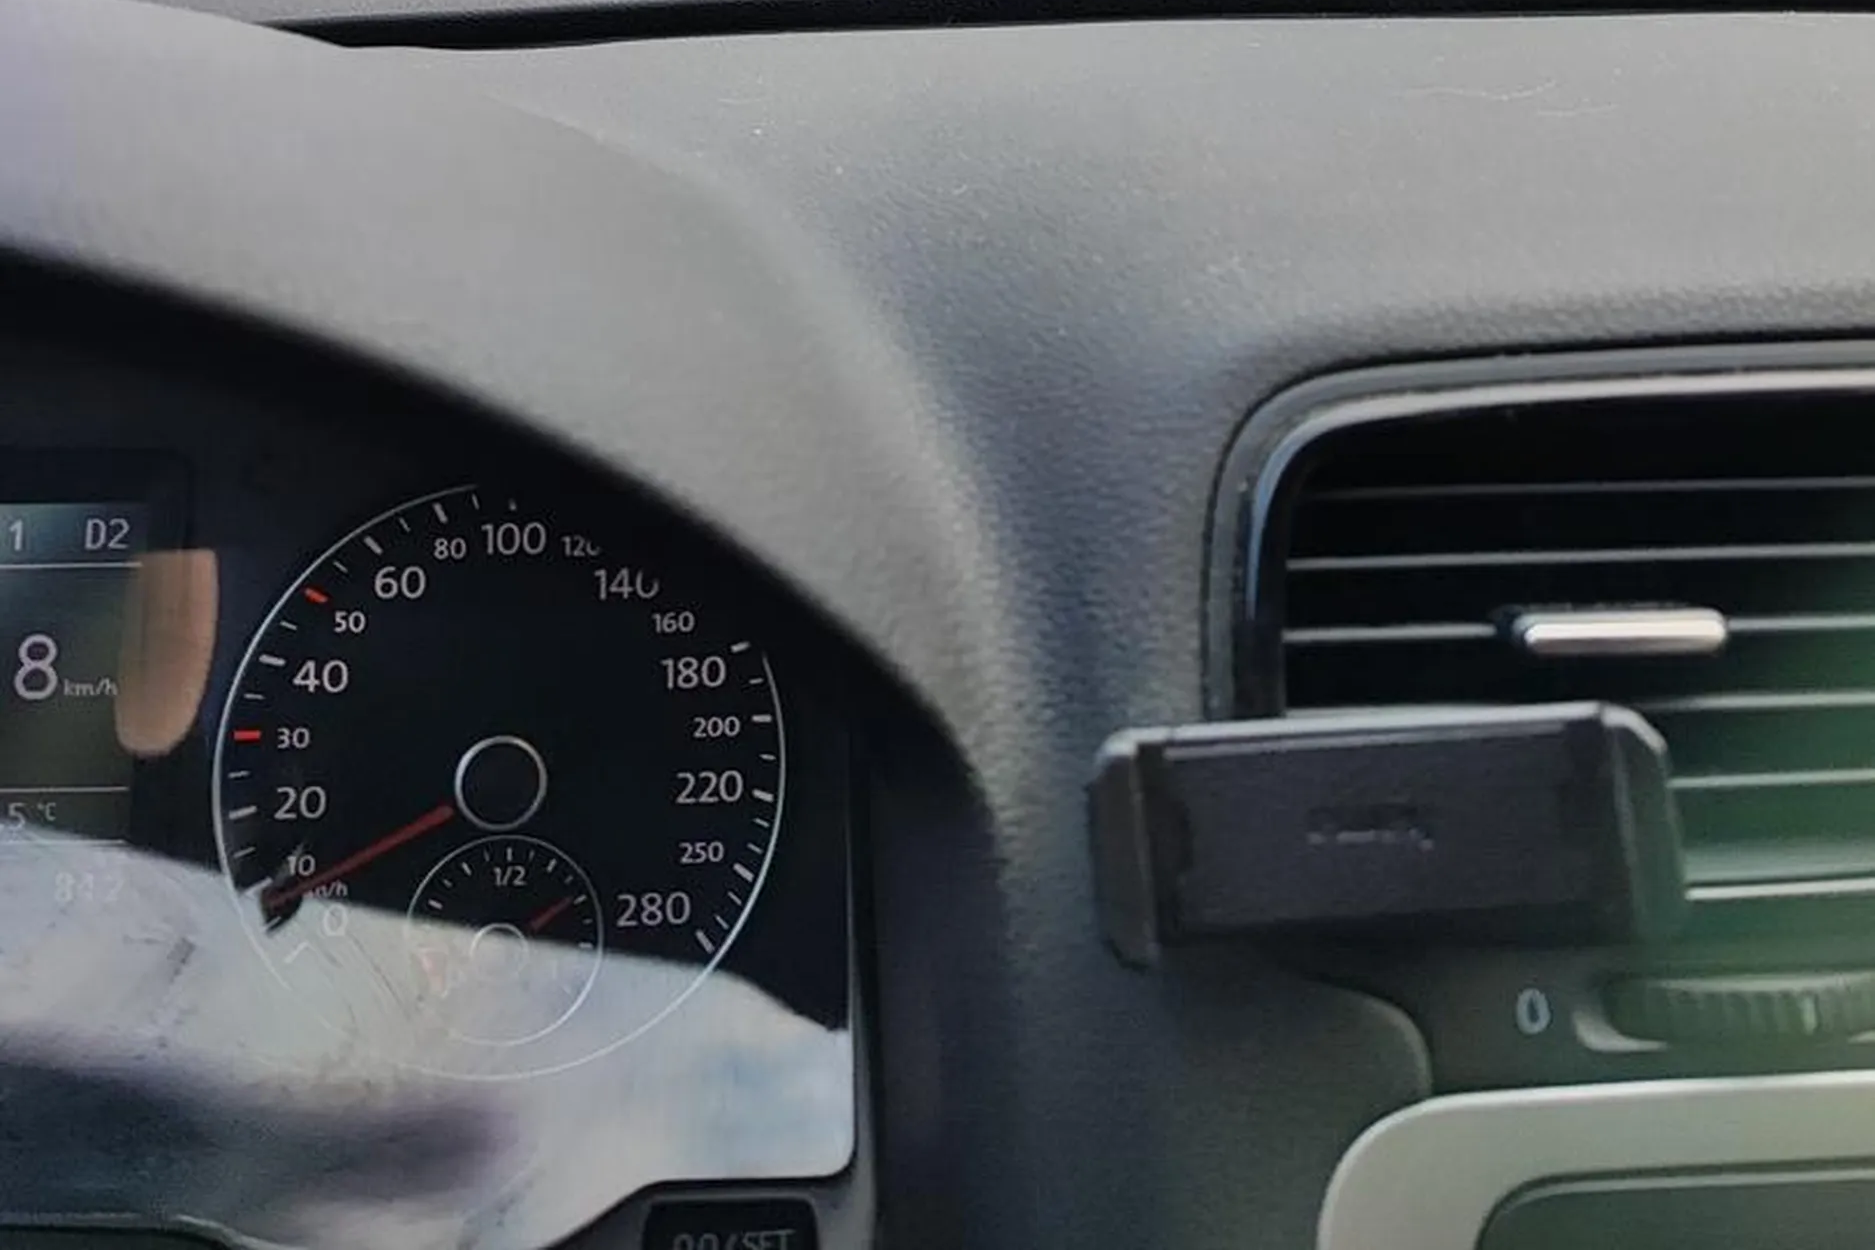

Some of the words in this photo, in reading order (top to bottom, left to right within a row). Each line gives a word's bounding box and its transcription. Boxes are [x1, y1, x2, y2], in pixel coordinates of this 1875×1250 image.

[84, 519, 130, 550] D2
[433, 538, 467, 559] 80
[481, 522, 547, 554] 100
[373, 566, 426, 599] 60
[594, 567, 661, 601] 140
[333, 611, 366, 633] 50
[652, 611, 696, 634] 160
[14, 634, 58, 700] 8
[63, 678, 118, 698] km/h
[292, 660, 349, 693] 40
[660, 656, 727, 689] 180
[276, 727, 310, 748] 30
[693, 716, 741, 738] 200
[273, 786, 327, 820] 20
[676, 770, 743, 805] 220
[287, 854, 316, 876] 10
[679, 842, 724, 864] 250
[494, 867, 528, 887] 1/2
[616, 892, 692, 927] 280
